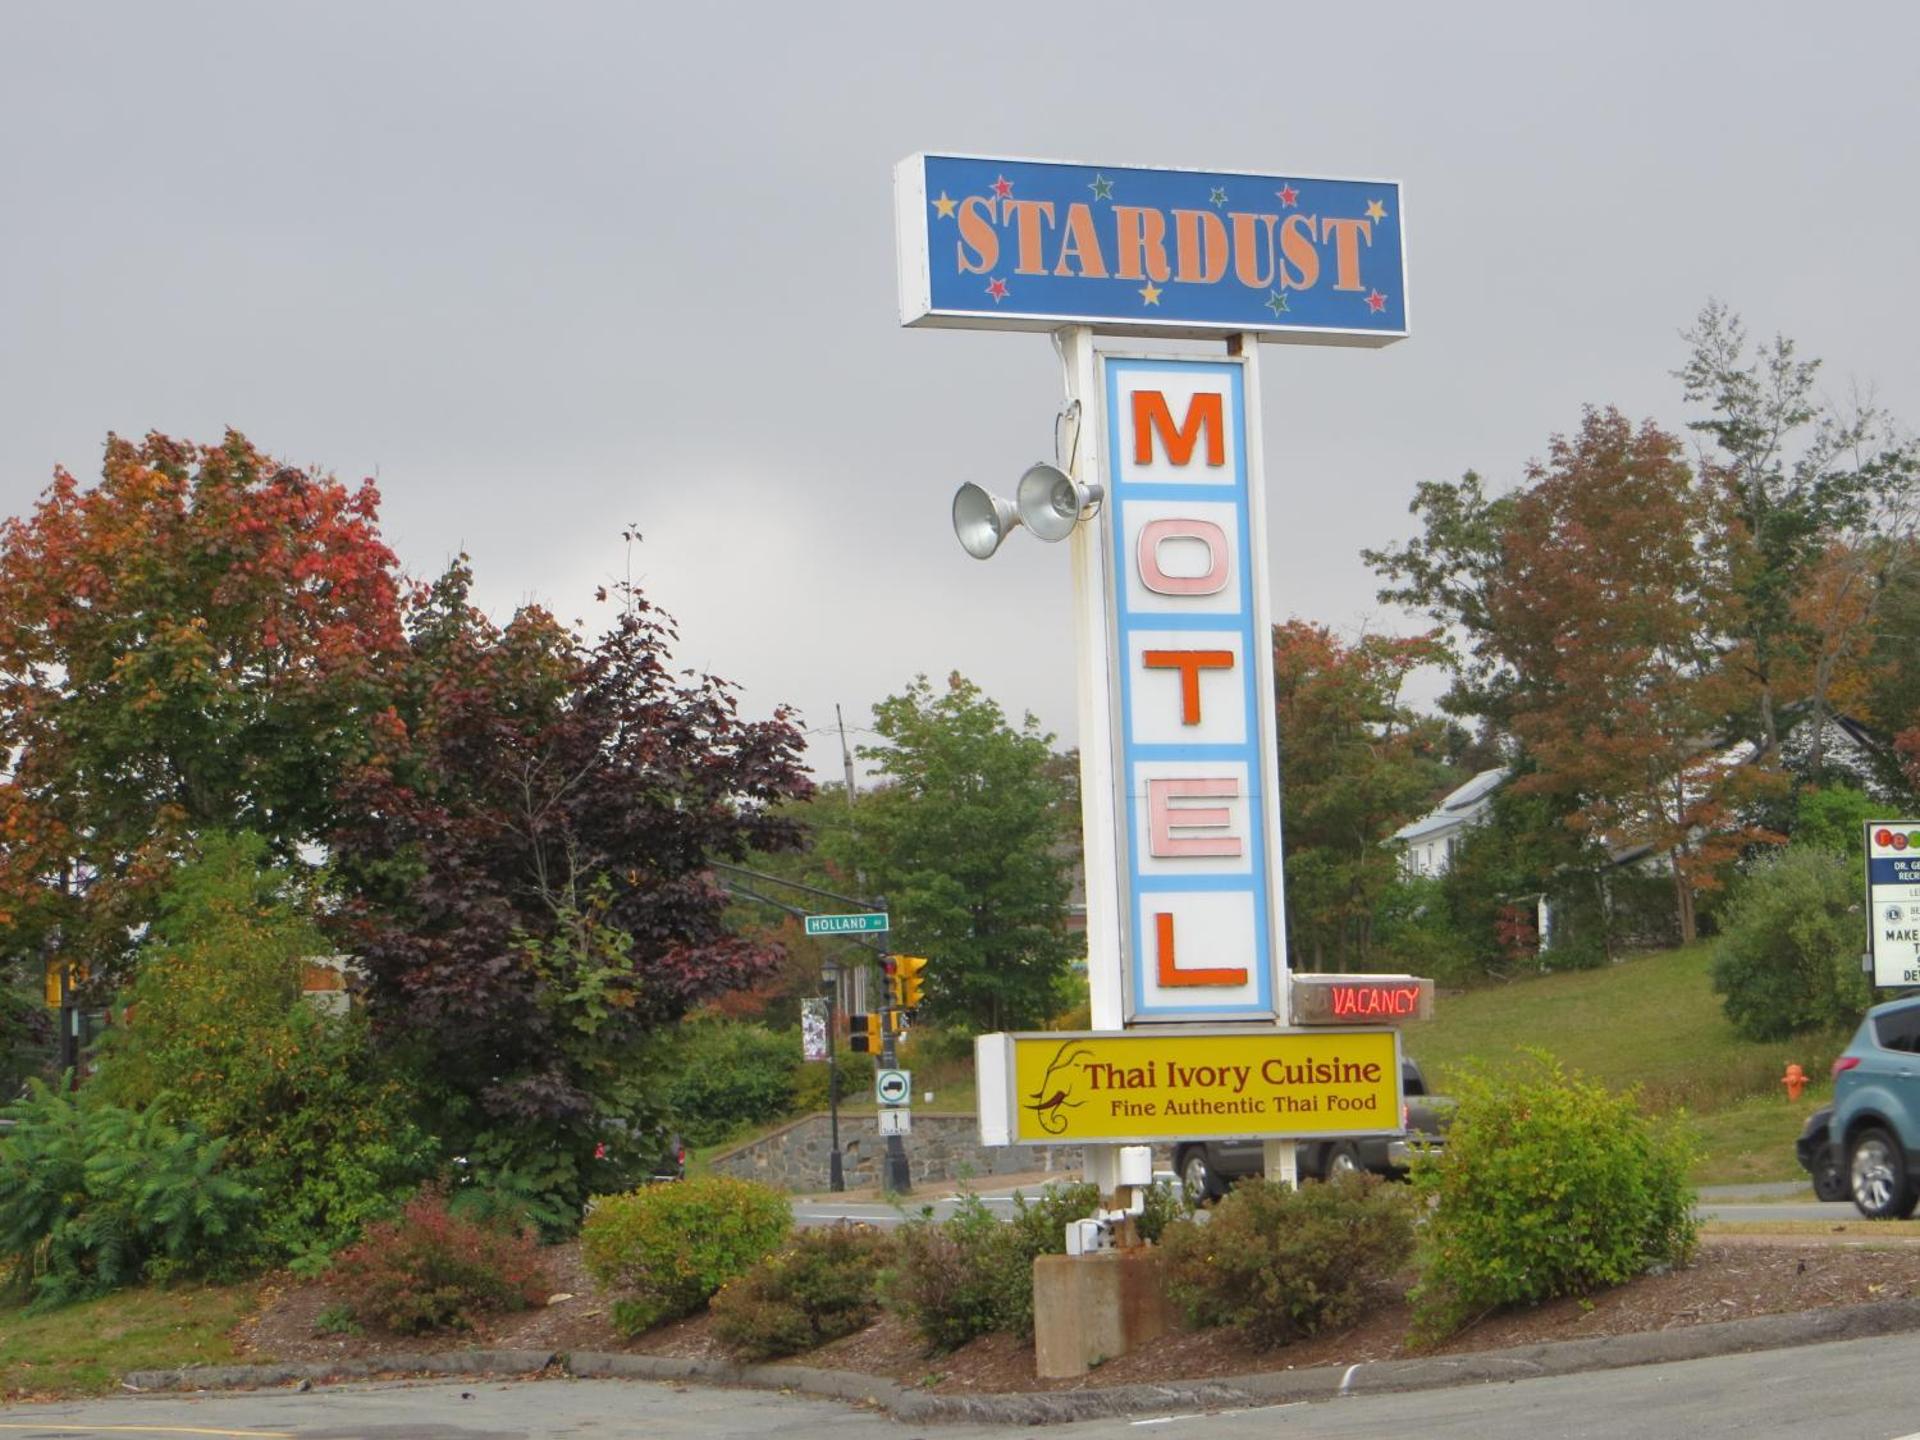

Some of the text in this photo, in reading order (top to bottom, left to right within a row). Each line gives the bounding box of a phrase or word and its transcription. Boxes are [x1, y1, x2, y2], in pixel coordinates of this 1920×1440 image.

[957, 195, 1373, 292] STARDUST
[1131, 390, 1248, 988] MOTEL
[812, 917, 866, 931] HOLLAND
[1886, 930, 1918, 941] MAKE
[1904, 970, 1920, 981] DE
[1332, 986, 1419, 1014] VACANCY
[1083, 1057, 1382, 1093] Thai Ivory Cuisine
[1111, 1094, 1377, 1117] Fine Authentic Thai Food
